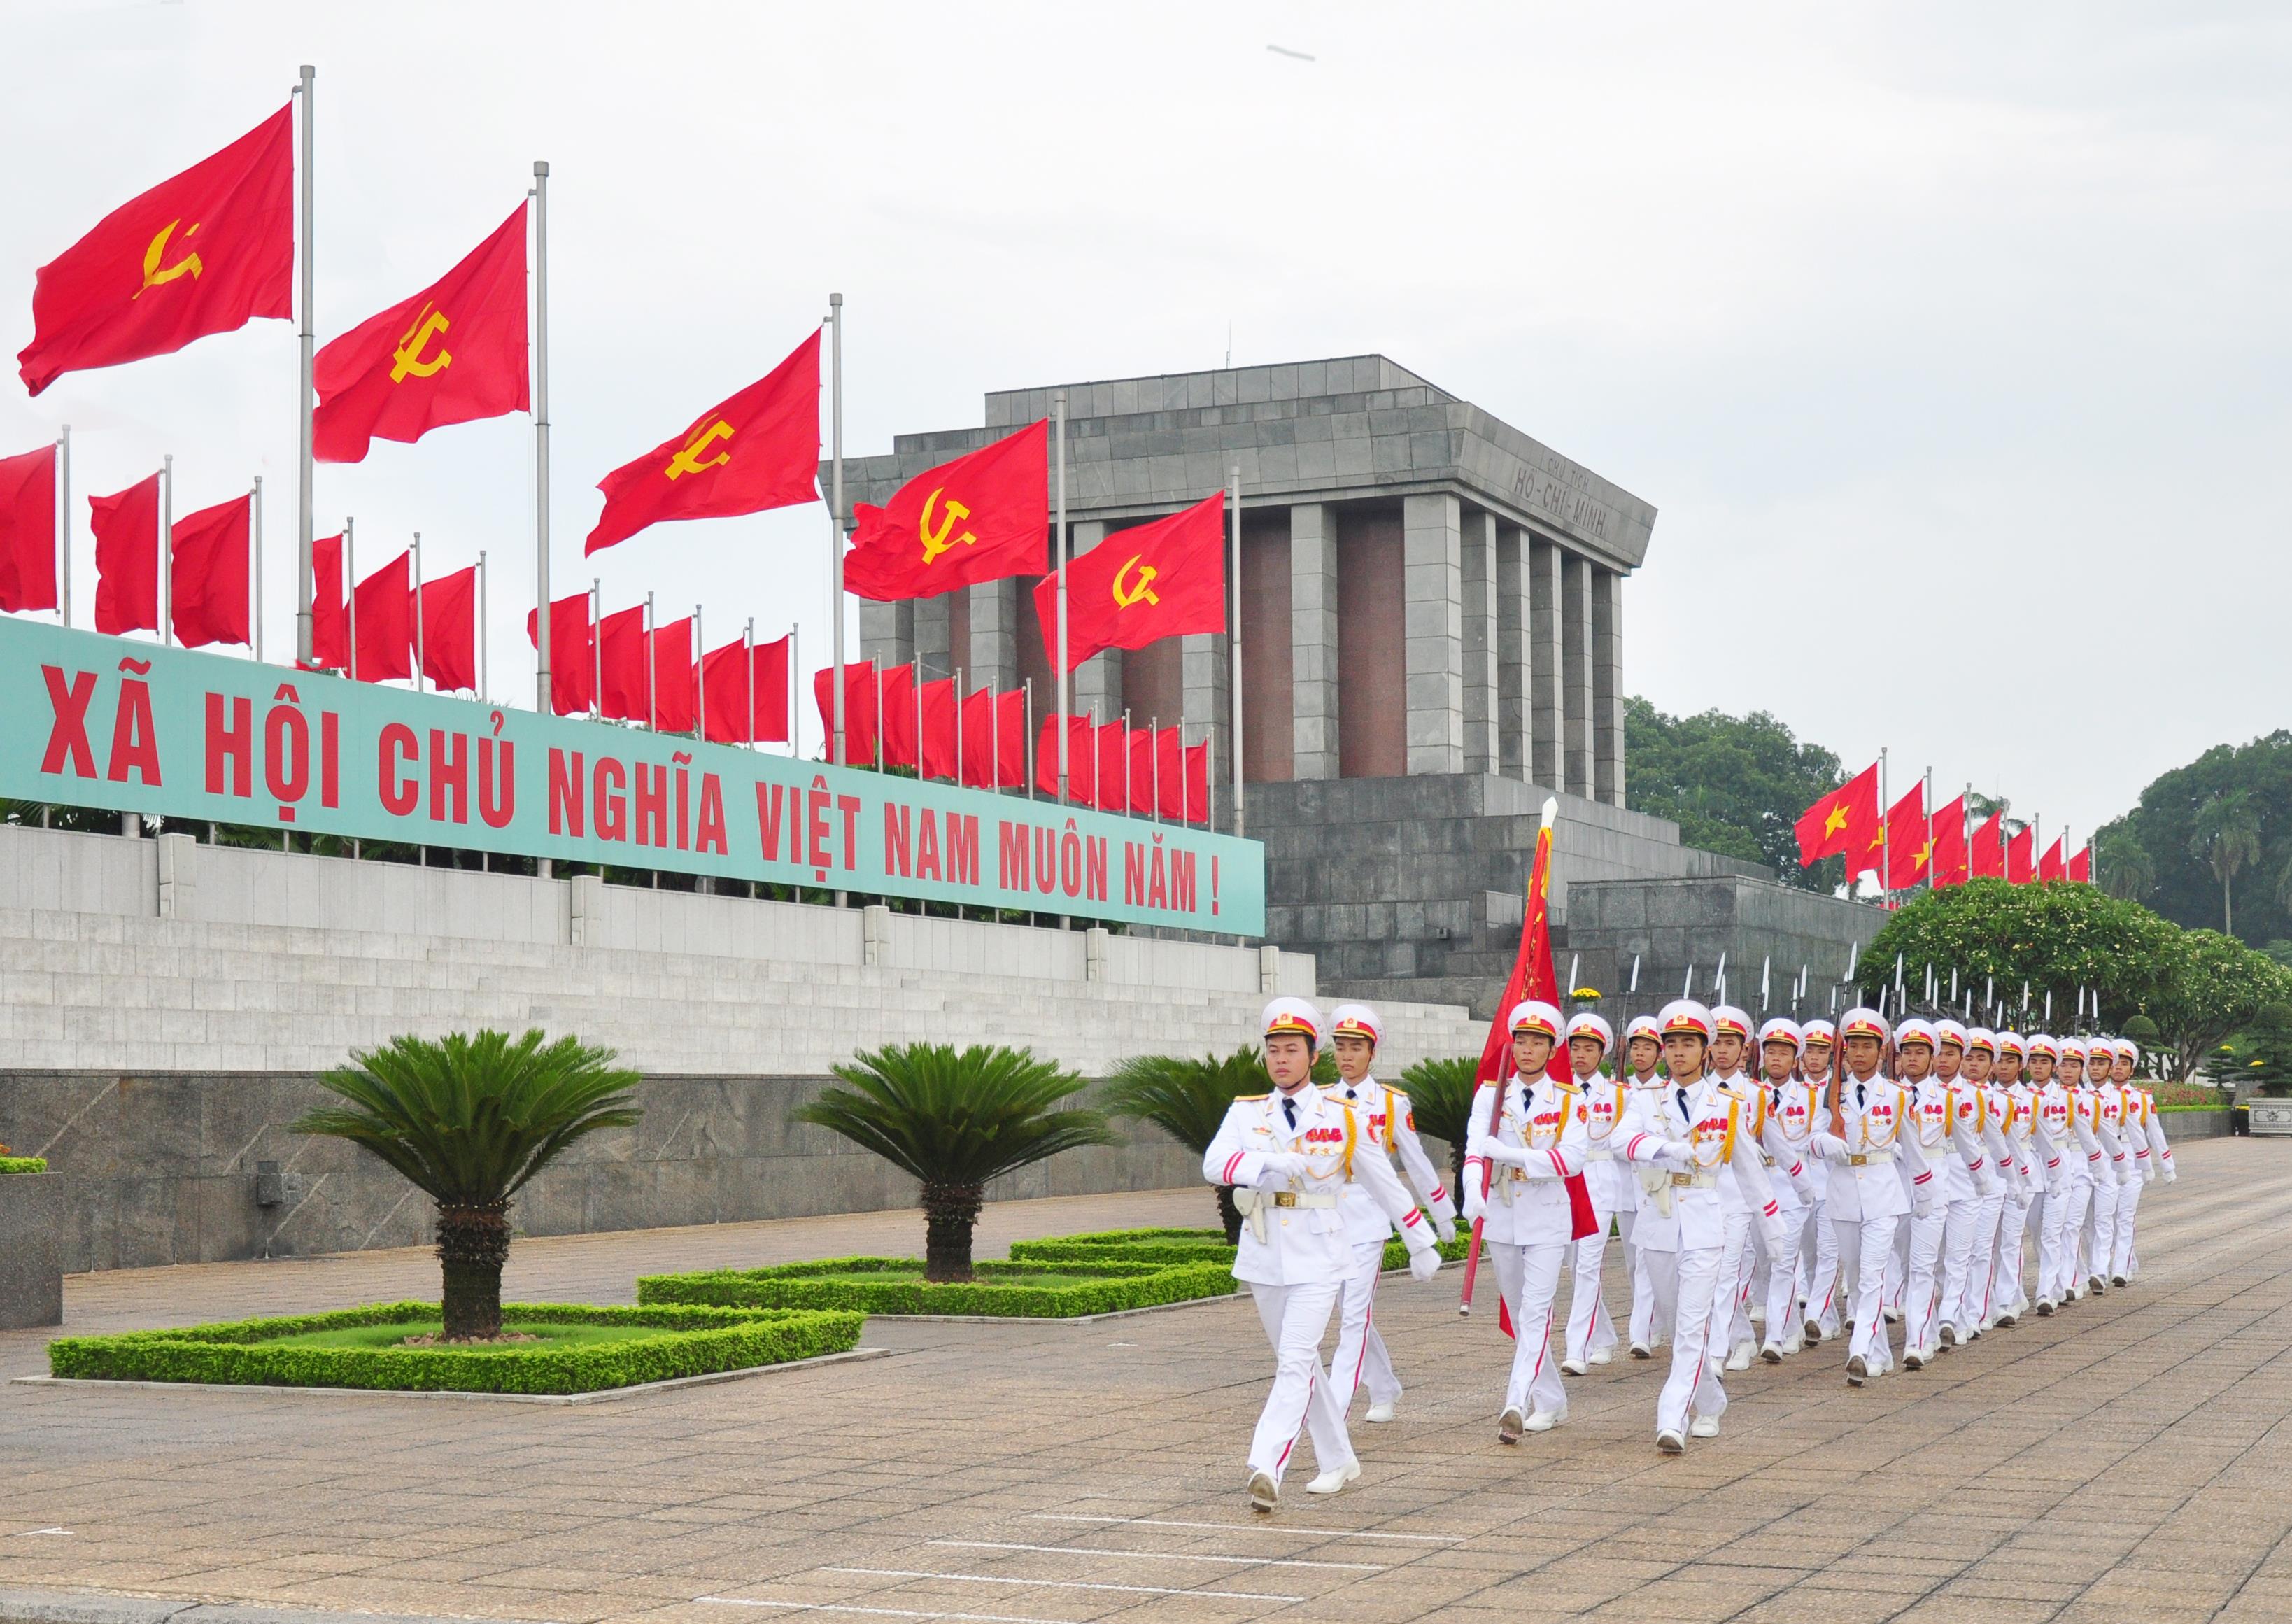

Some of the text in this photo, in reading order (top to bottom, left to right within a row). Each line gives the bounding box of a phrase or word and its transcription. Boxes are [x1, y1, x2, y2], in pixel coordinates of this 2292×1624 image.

[41, 656, 162, 786] XÃ
[205, 684, 339, 822] HỘI
[379, 711, 515, 828] CHỦ
[549, 747, 729, 856] NGHĨA
[755, 775, 861, 882] VIỆT
[884, 802, 979, 886] NAM
[998, 817, 1108, 902] MUÔN
[1124, 831, 1196, 912] NĂM
